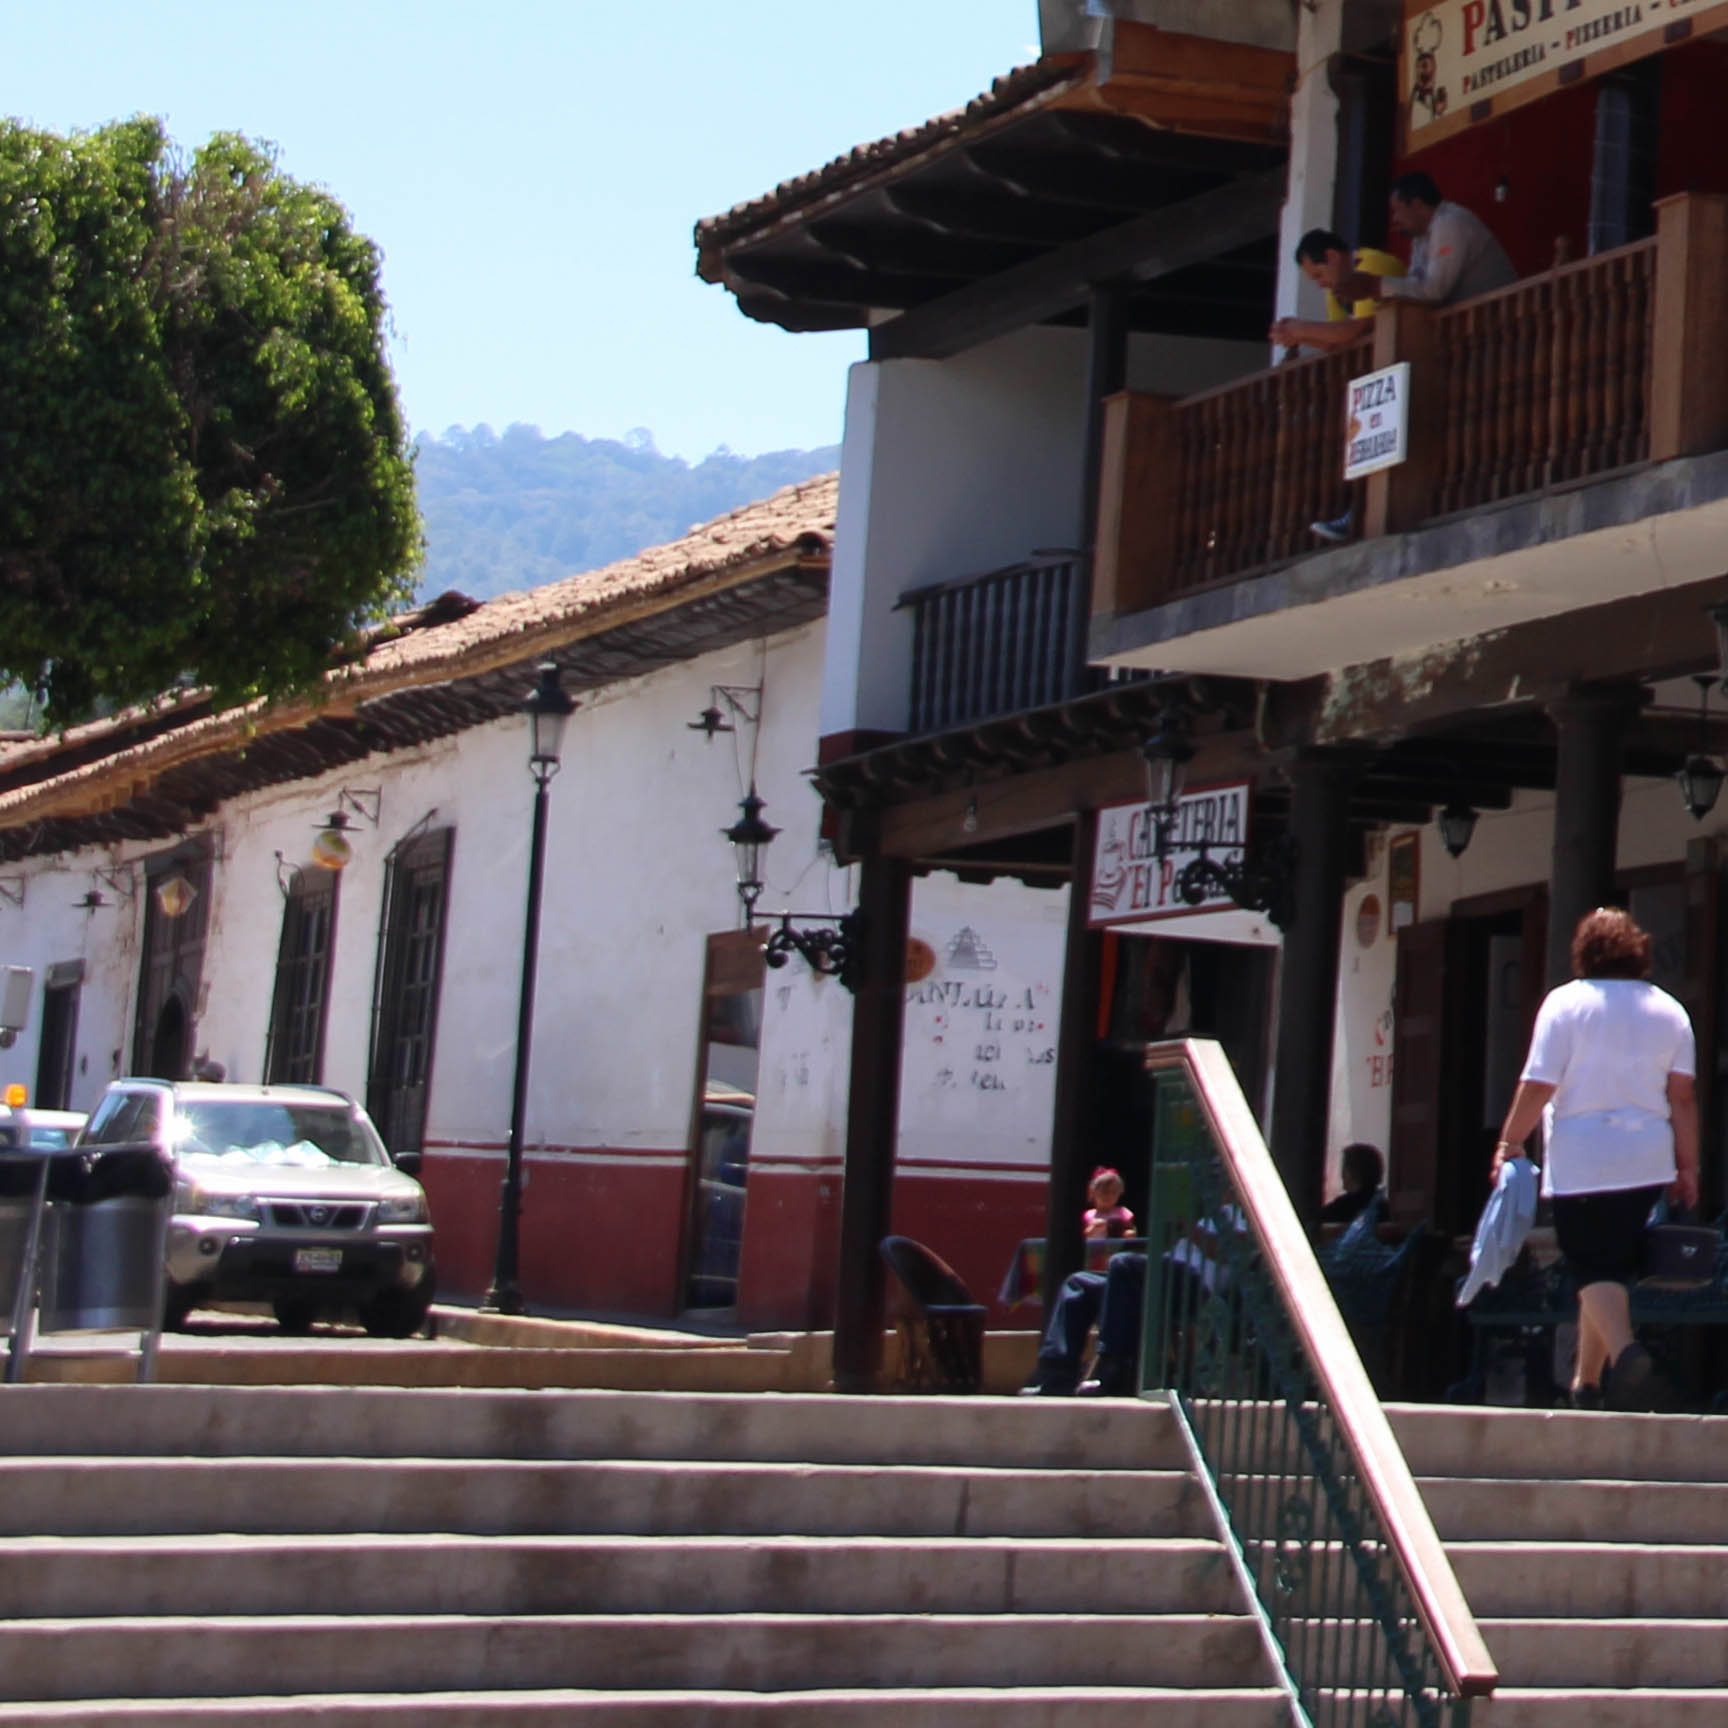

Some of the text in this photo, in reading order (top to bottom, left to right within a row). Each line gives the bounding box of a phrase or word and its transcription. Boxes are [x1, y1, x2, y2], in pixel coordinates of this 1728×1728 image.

[1463, 41, 1545, 95] PASTELERIA
[1565, 5, 1642, 51] PIZZERIA
[1353, 374, 1396, 416] PIZZA
